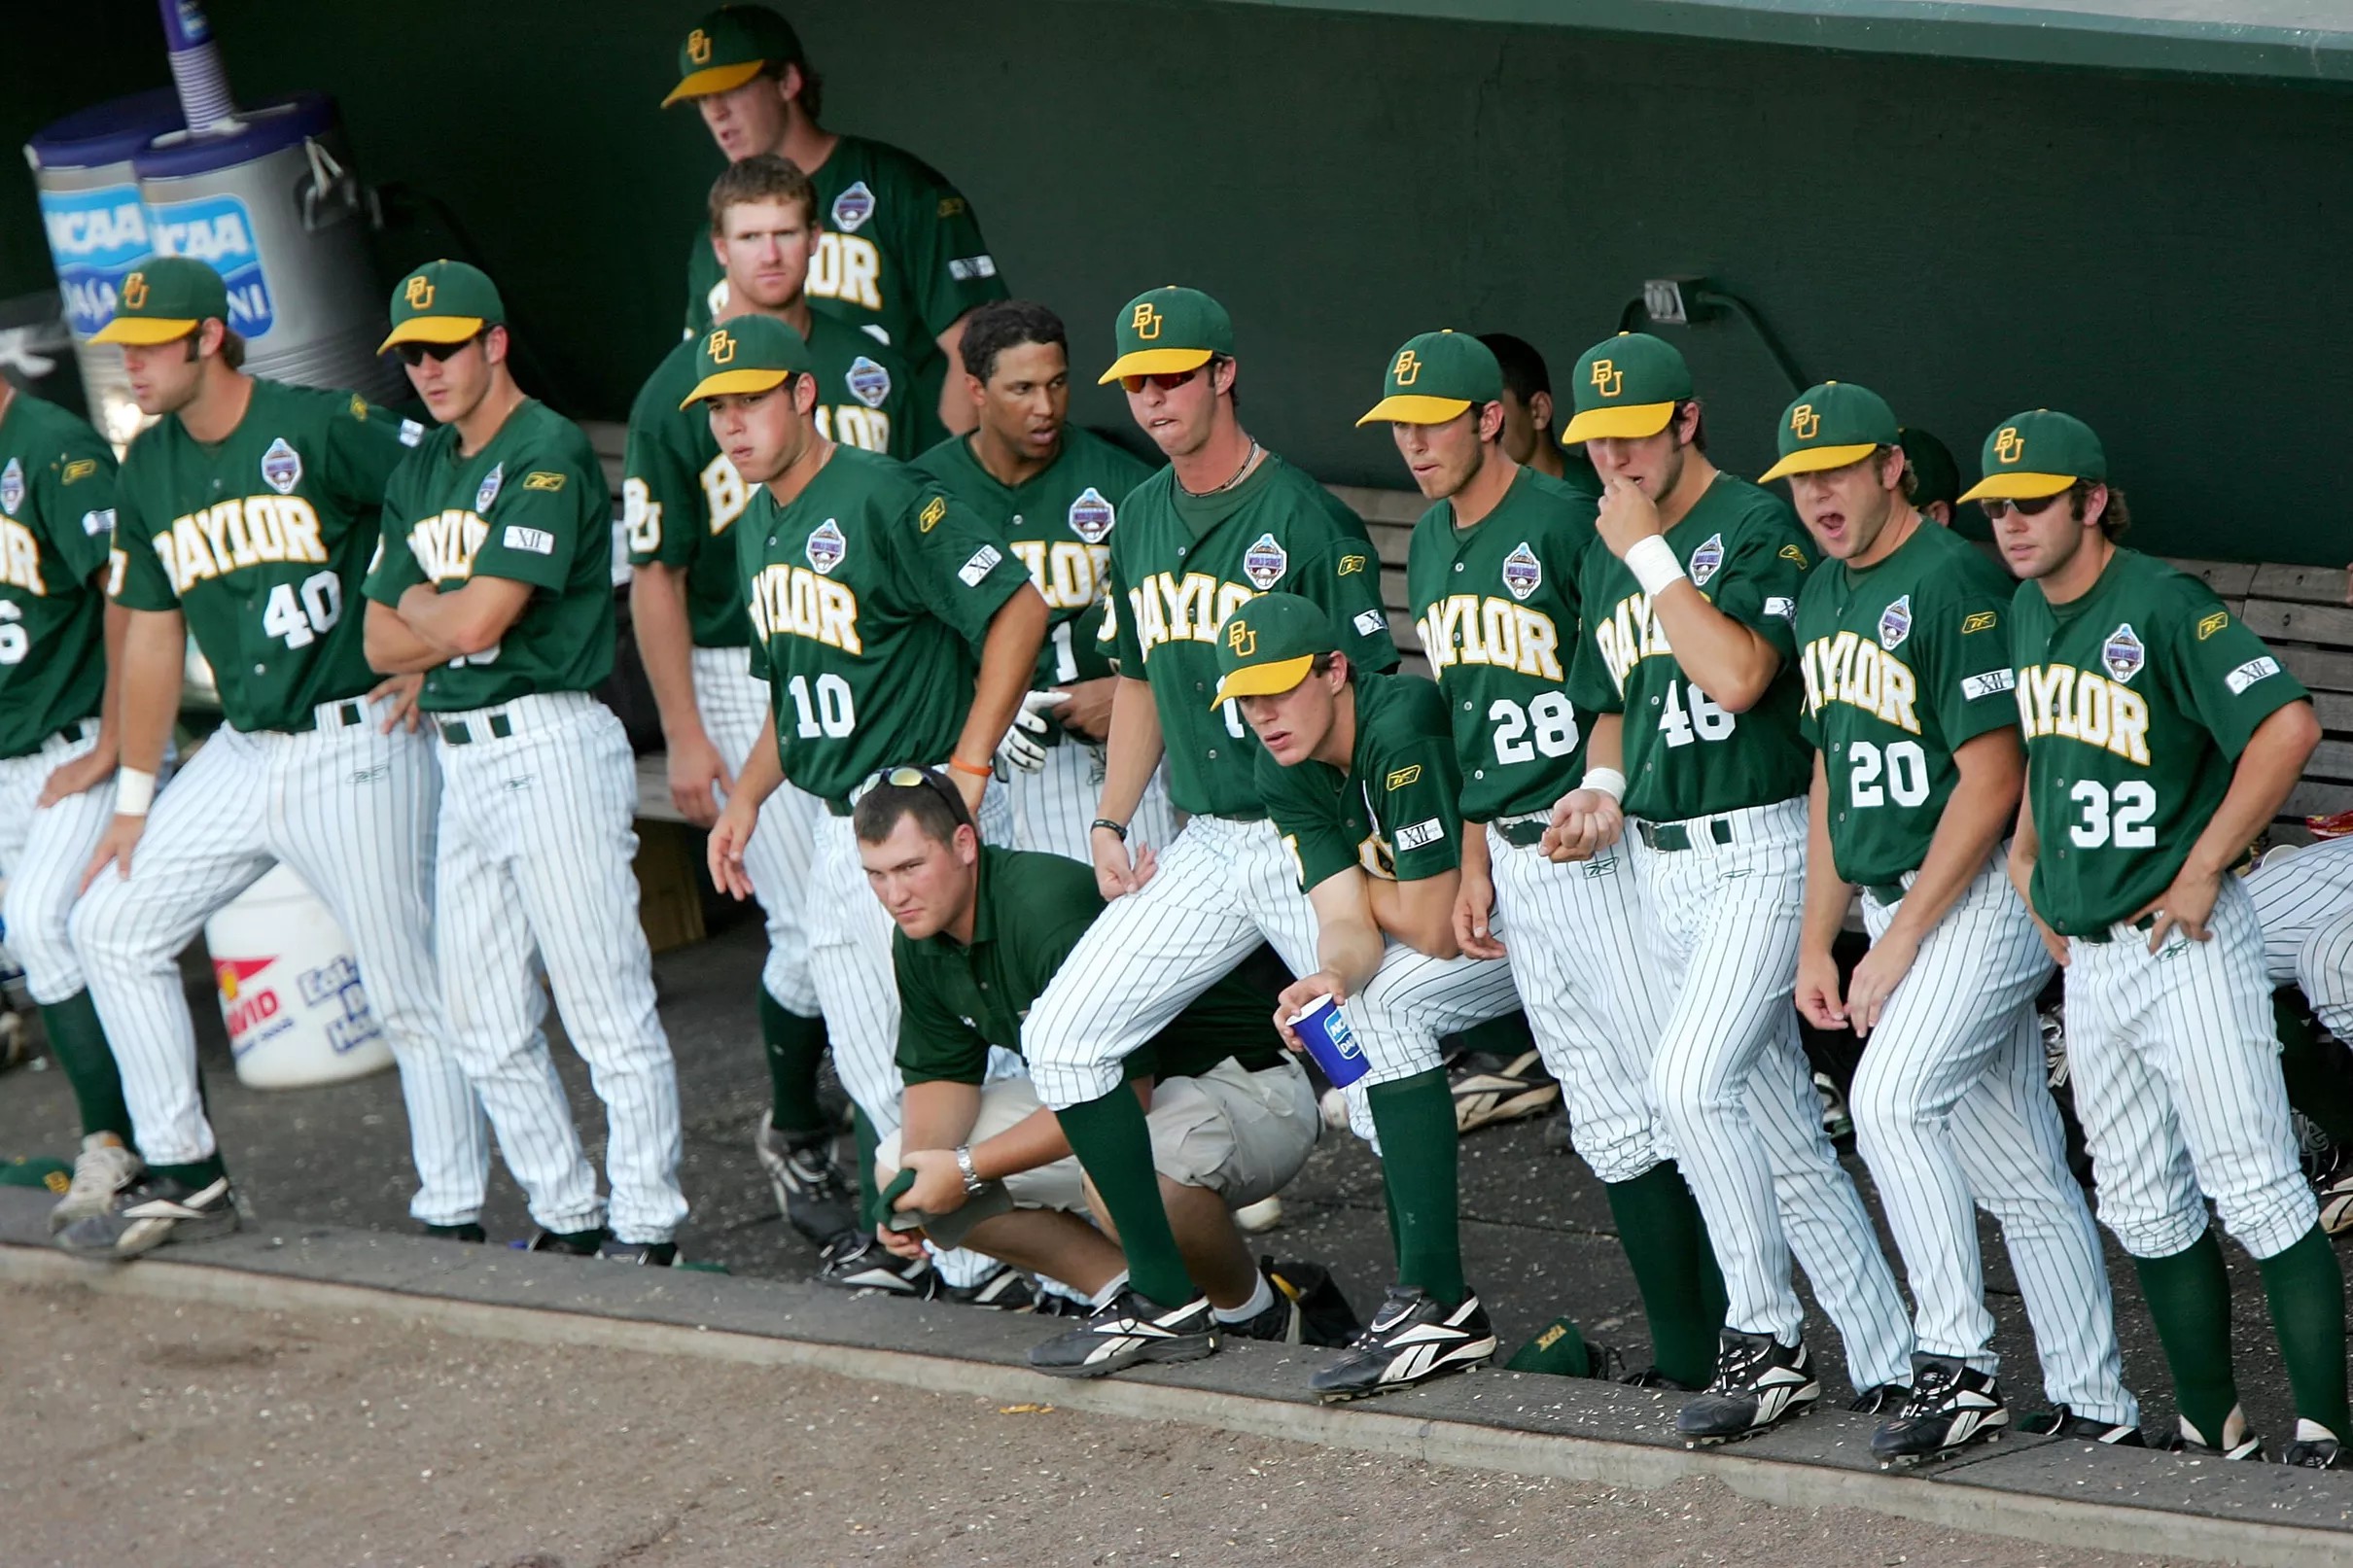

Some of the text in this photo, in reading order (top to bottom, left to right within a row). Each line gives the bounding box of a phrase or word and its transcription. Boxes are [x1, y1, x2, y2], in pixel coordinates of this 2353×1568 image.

[686, 28, 713, 65] BU
[404, 275, 436, 310] BU
[1131, 302, 1163, 340] BU
[707, 329, 737, 365] BU
[1392, 349, 1422, 386] BU
[1590, 359, 1625, 398] BU
[1790, 403, 1820, 440] BU
[1993, 427, 2025, 465] BU
[263, 570, 342, 650] 40
[1228, 619, 1256, 657] BU
[1801, 630, 1922, 736] AYLOR
[789, 673, 857, 740] 10
[1658, 679, 1737, 749] 46
[1489, 690, 1580, 765] 28
[1849, 740, 1931, 808] 20
[2070, 780, 2157, 849] 32
[227, 988, 280, 1039] VID
